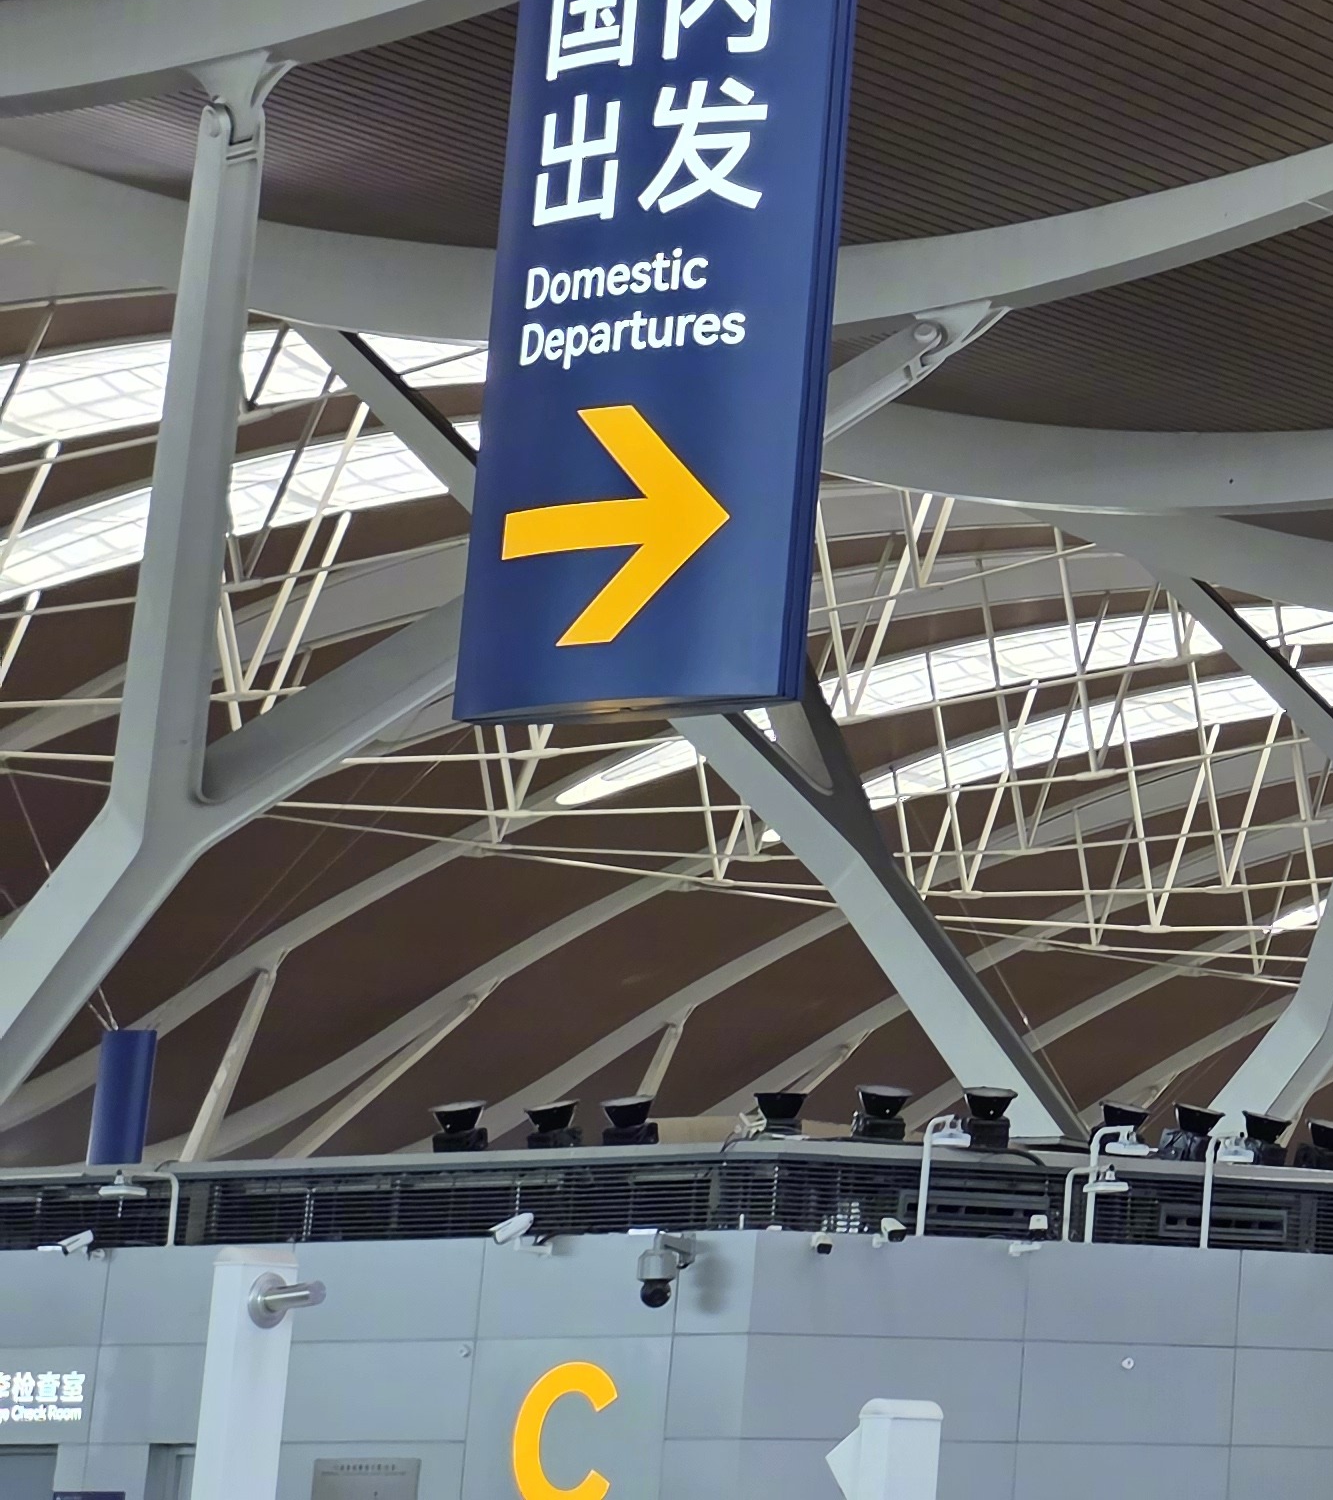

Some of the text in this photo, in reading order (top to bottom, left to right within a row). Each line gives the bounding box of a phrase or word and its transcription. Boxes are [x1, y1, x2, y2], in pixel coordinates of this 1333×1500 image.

[531, 77, 770, 228] 出发
[523, 246, 709, 311] Domestic
[518, 309, 747, 371] Departures
[48, 1404, 82, 1421] Room
[512, 1360, 619, 1500] C
